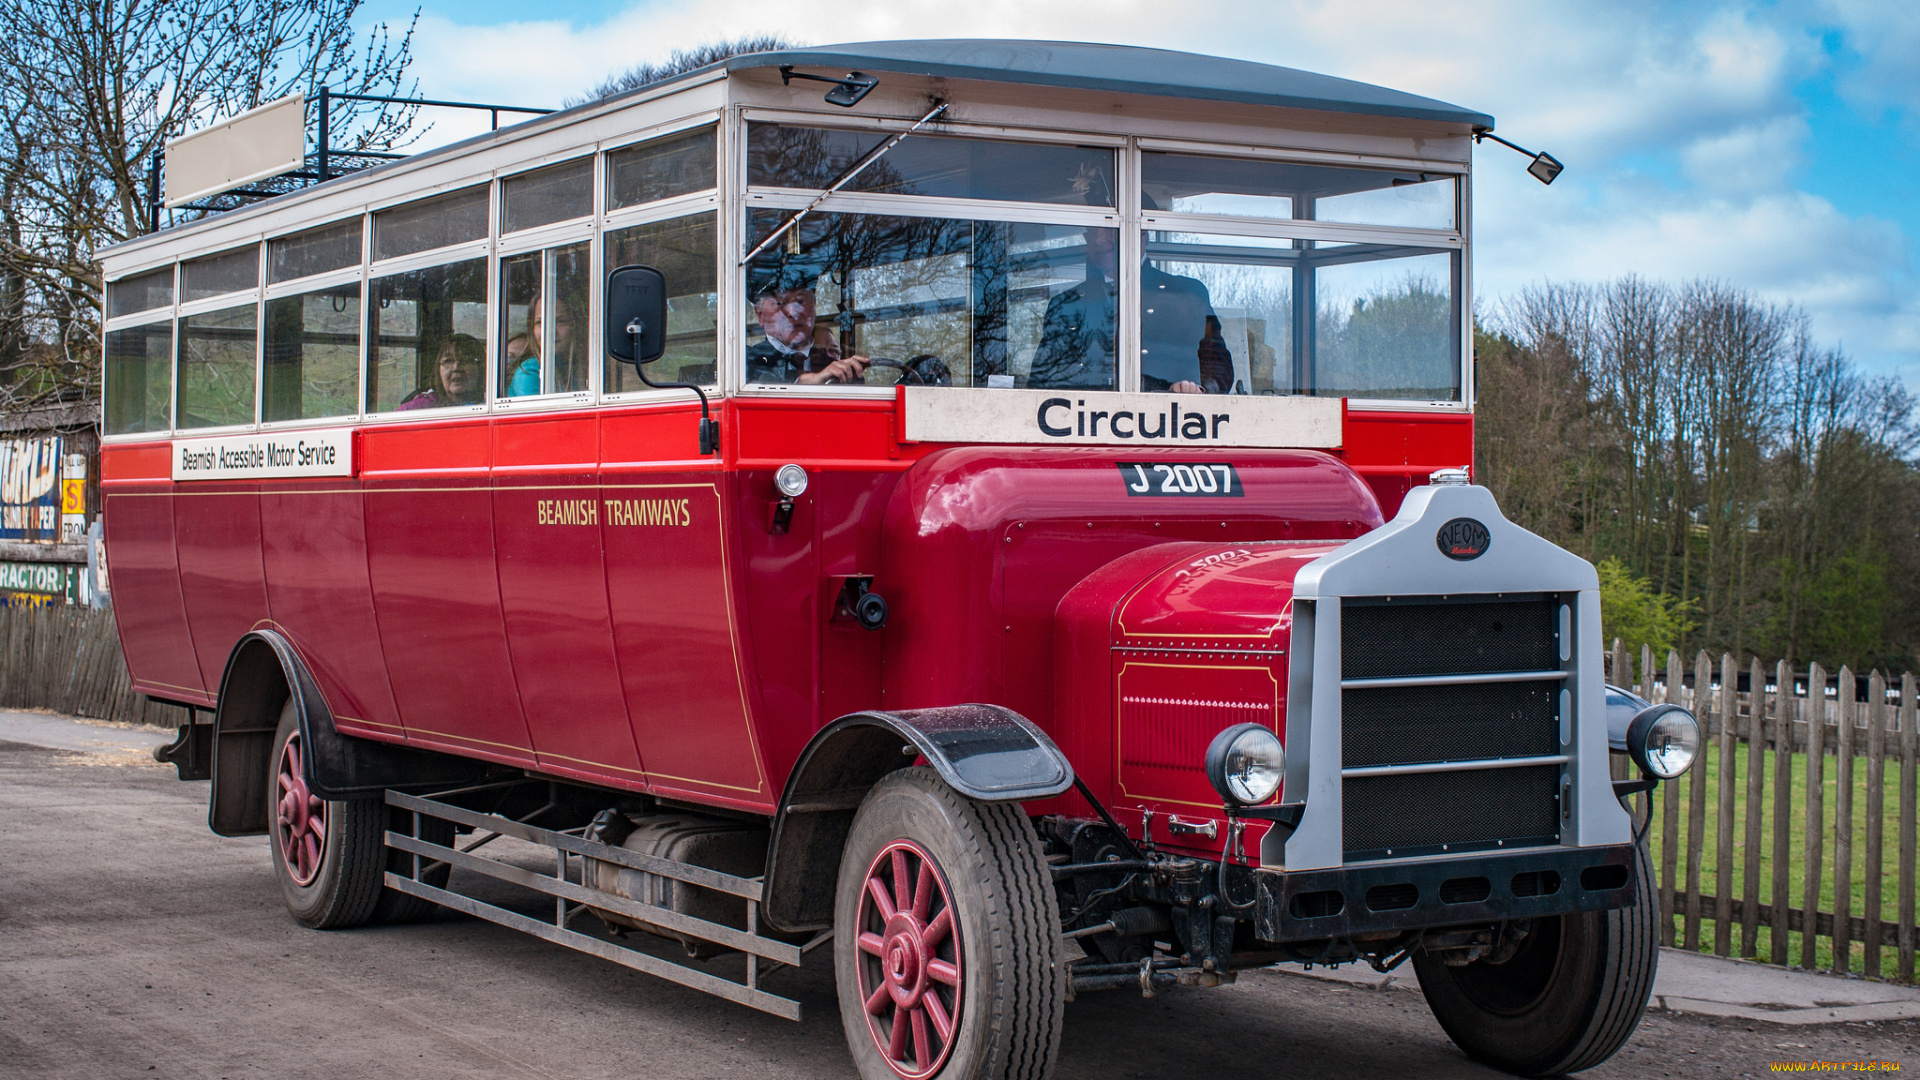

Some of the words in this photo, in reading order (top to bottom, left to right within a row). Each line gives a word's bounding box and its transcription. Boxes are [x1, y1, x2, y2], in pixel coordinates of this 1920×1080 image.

[1037, 397, 1230, 440] Circular
[182, 446, 216, 471] Beamish
[219, 443, 264, 469] Accessible
[267, 442, 295, 467] Motor
[298, 440, 336, 466] Service
[1130, 464, 1150, 492] J
[1153, 464, 1231, 493] 2007
[537, 499, 598, 525] BEAMISH
[604, 498, 691, 527] TRAMWAYS
[1441, 522, 1487, 549] NEOM
